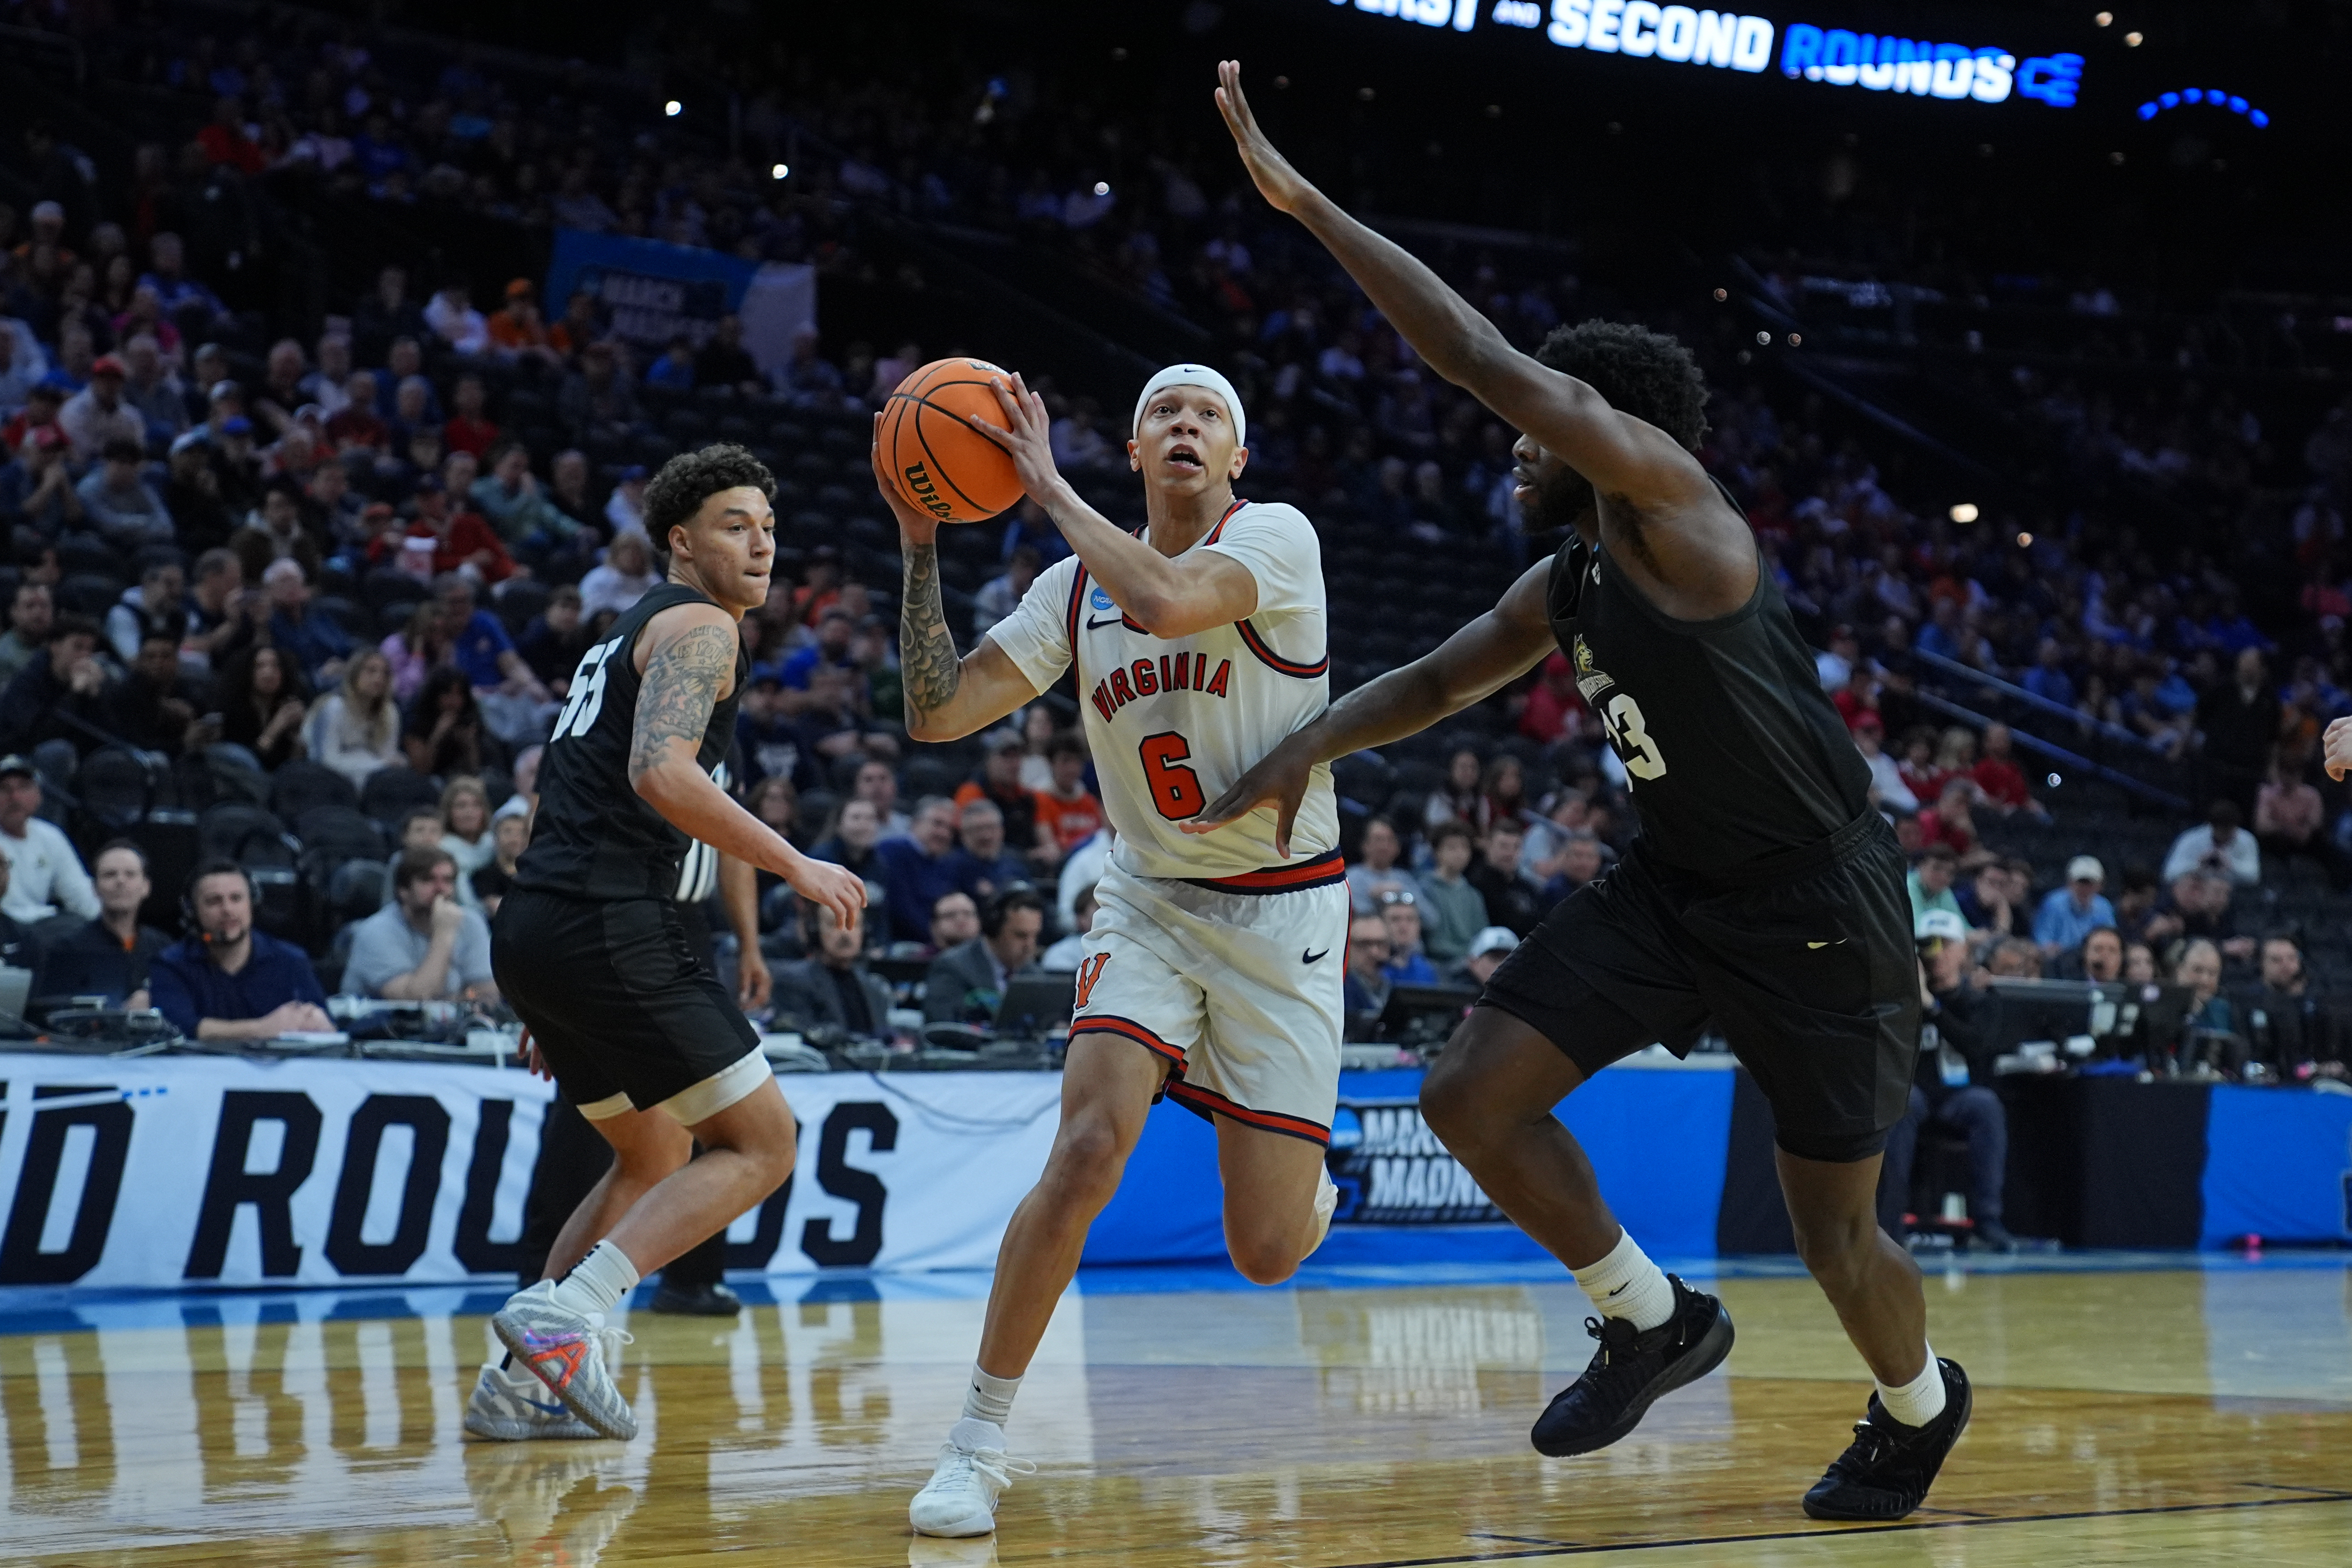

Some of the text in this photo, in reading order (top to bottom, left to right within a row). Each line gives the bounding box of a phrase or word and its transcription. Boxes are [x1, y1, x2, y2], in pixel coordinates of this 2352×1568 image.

[1547, 0, 1774, 72] SECOND
[1781, 23, 2014, 103] ROUNDS
[1093, 595, 1113, 604] NCAA
[550, 635, 624, 743] 55
[1092, 652, 1231, 723] VIRGINIA
[1139, 731, 1206, 821] 6
[1600, 694, 1666, 792] 3
[1075, 952, 1111, 1010] V
[0, 1081, 899, 1283] D ROUS
